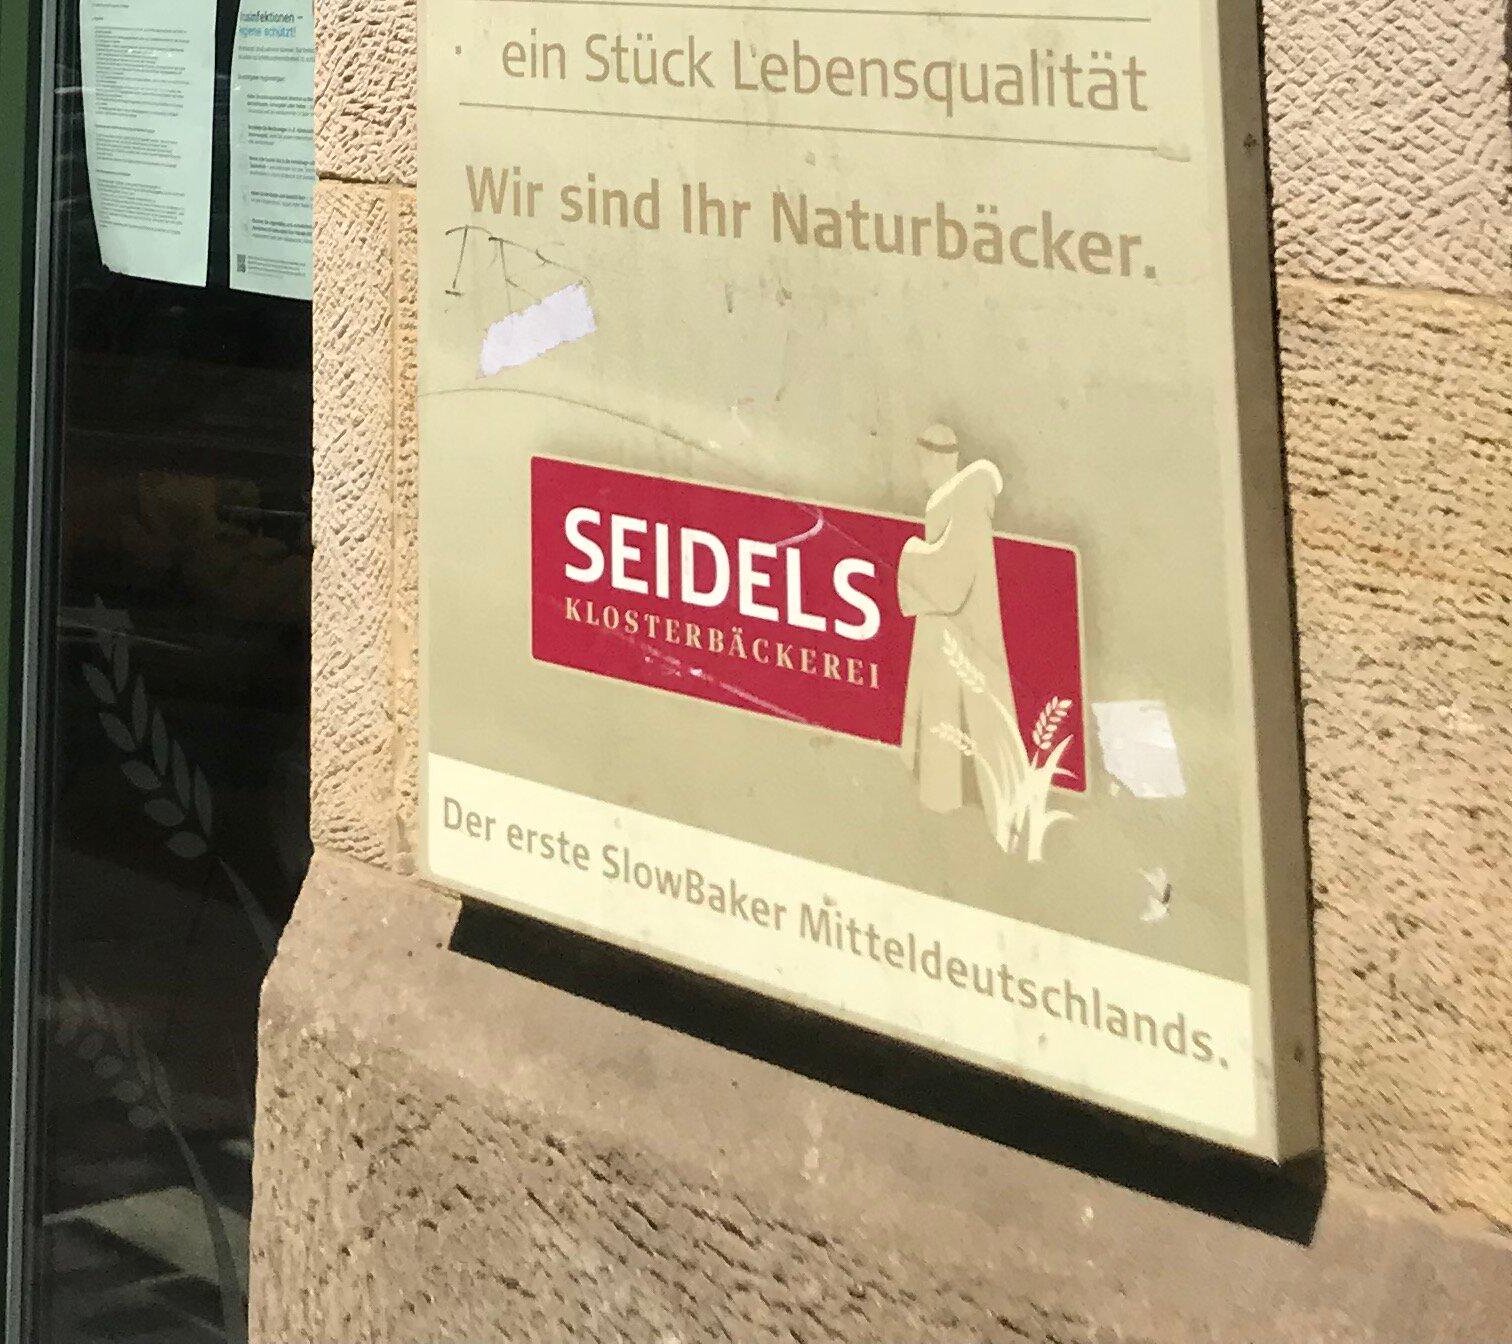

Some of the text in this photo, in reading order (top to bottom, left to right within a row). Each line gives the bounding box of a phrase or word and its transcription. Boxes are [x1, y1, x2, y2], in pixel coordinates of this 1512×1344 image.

[501, 28, 1150, 119] ein Stück Lebensqualität
[465, 164, 1159, 281] Wir sind Ihr Naturbäcker.
[563, 505, 882, 641] SEIDELS
[564, 596, 881, 691] KLOSTERBÄCKEREI
[441, 795, 1231, 1073] Der erste SlowBaker Mitteldeutschlands.
